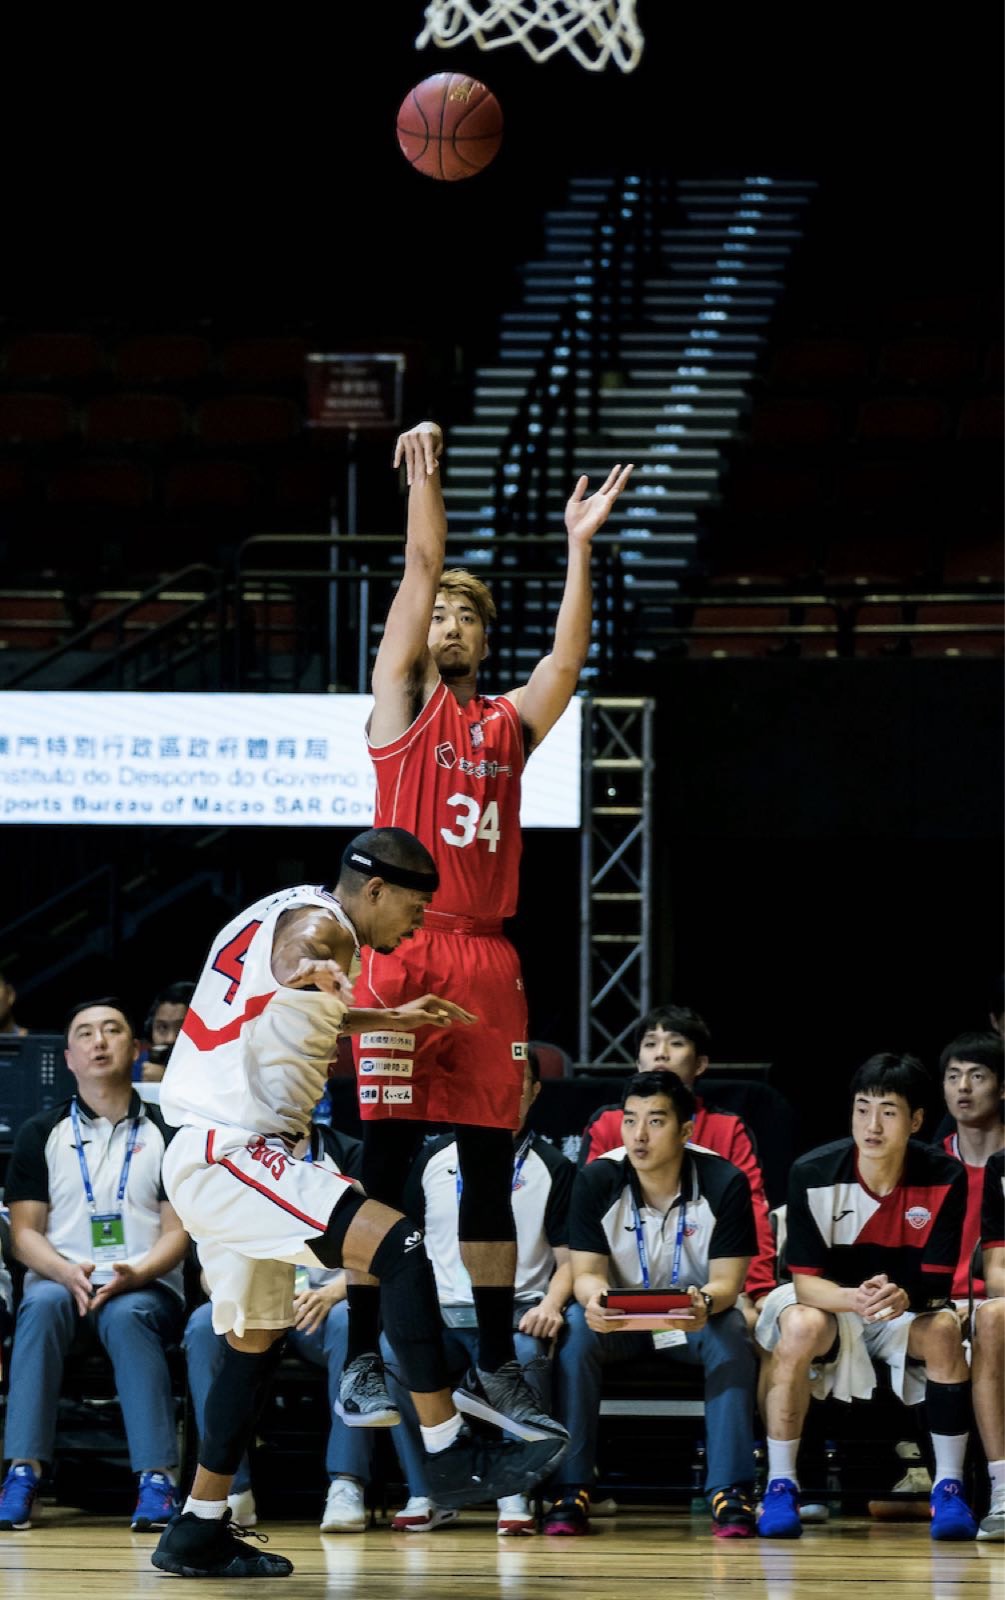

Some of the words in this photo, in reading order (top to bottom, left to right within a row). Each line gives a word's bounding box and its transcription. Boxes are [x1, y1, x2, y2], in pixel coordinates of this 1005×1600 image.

[0, 796, 62, 813] ports
[72, 796, 153, 812] Bureau
[162, 796, 184, 813] of
[192, 796, 264, 812] Macao
[273, 796, 321, 814] SAR
[440, 792, 501, 853] 34
